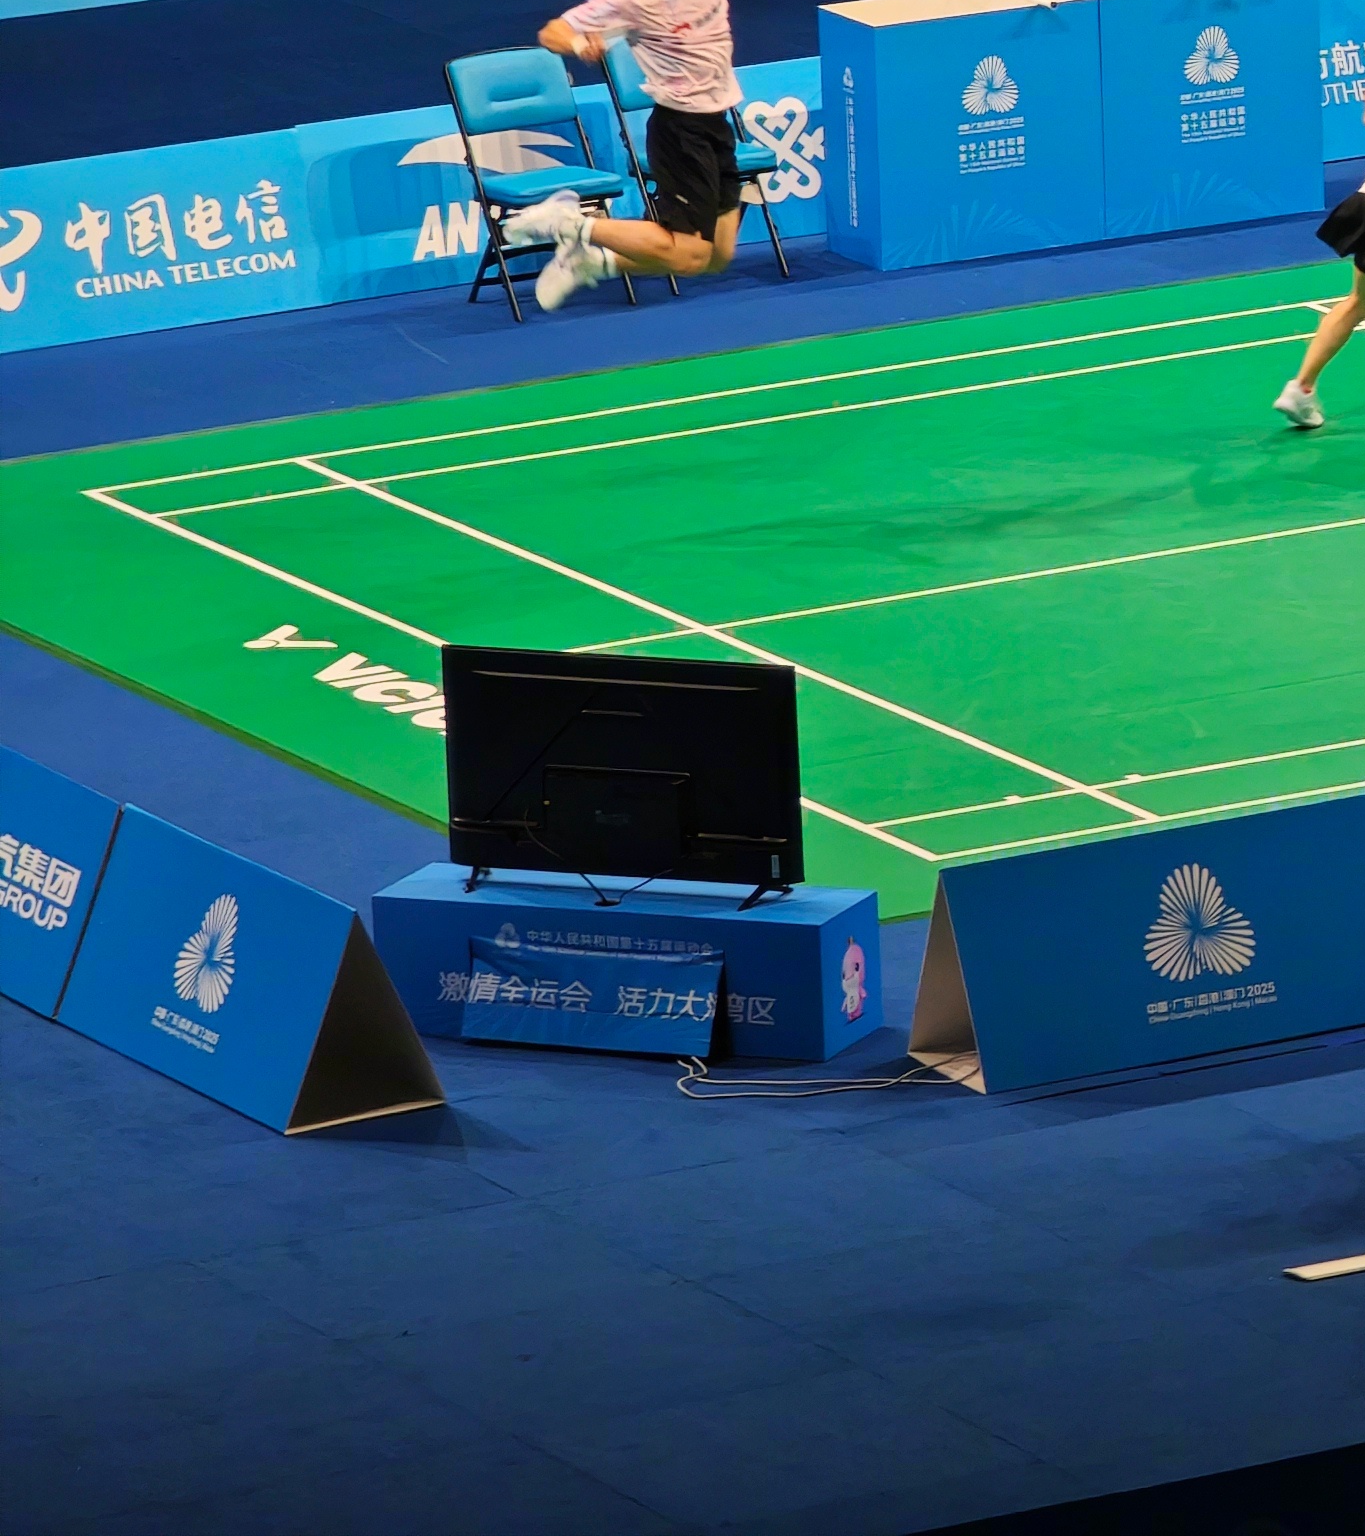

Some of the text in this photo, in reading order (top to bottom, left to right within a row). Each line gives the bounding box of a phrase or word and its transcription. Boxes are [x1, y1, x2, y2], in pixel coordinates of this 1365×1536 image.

[65, 178, 288, 274] 中国电信
[76, 249, 296, 300] CHINA TELECOM
[437, 972, 592, 1013] 激情全运会
[1247, 982, 1275, 997] 2025
